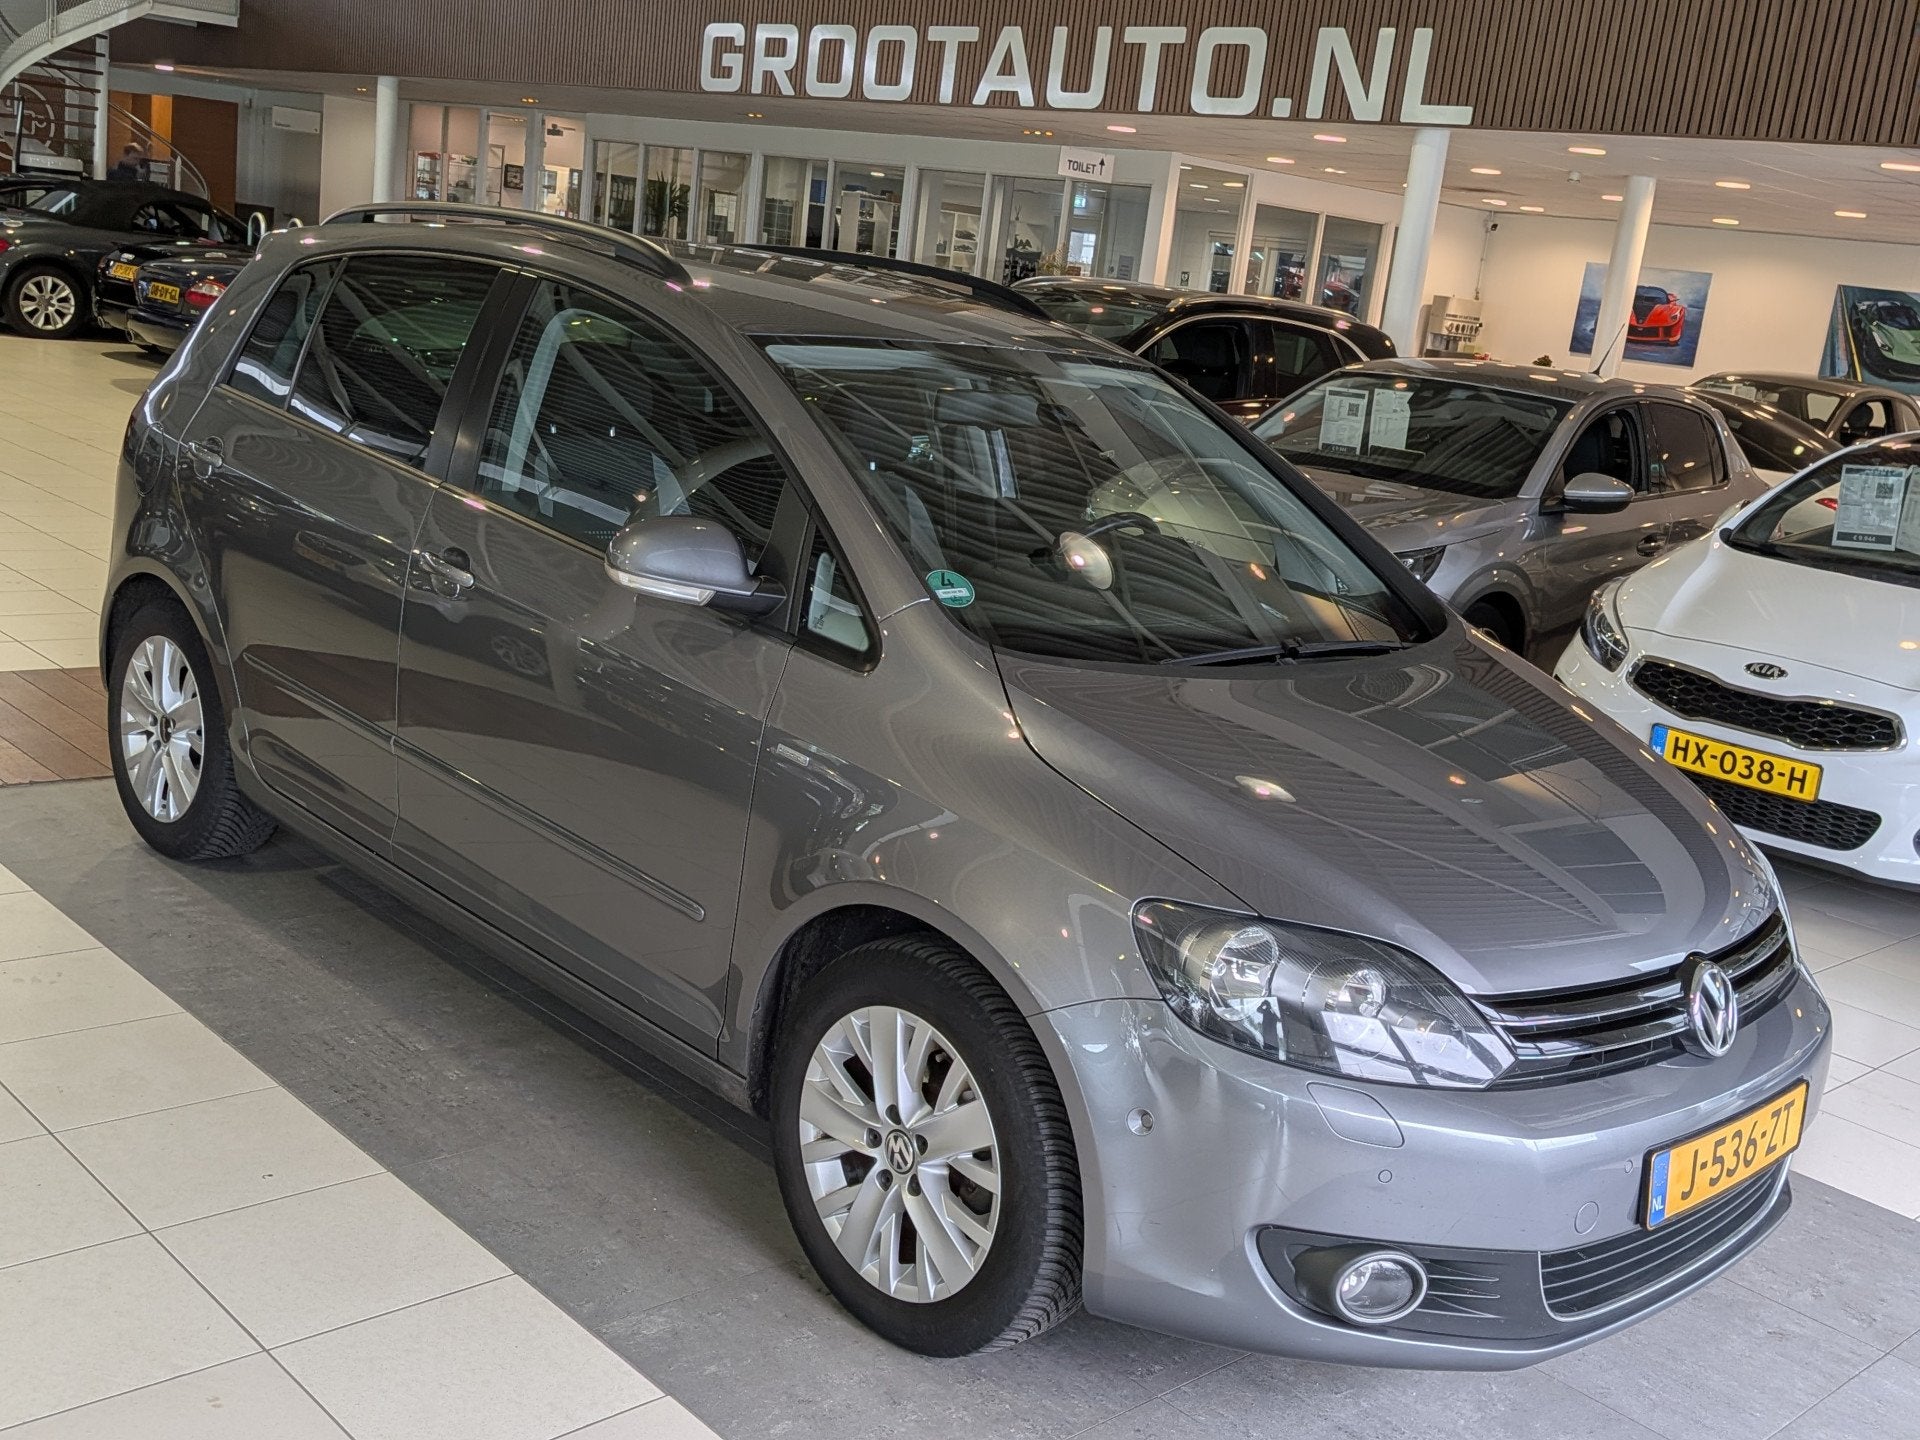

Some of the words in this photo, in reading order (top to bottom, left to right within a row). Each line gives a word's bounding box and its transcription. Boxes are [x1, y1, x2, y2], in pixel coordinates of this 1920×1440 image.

[700, 22, 1473, 125] GROOTAUTO.NL
[1067, 159, 1097, 174] TOILET
[941, 572, 955, 588] 4
[1750, 663, 1780, 680] KIA
[1652, 744, 1664, 756] NL
[1671, 736, 1809, 794] HX-038-H
[1680, 1099, 1796, 1201] J-536-ZT
[1652, 1197, 1664, 1213] NL
